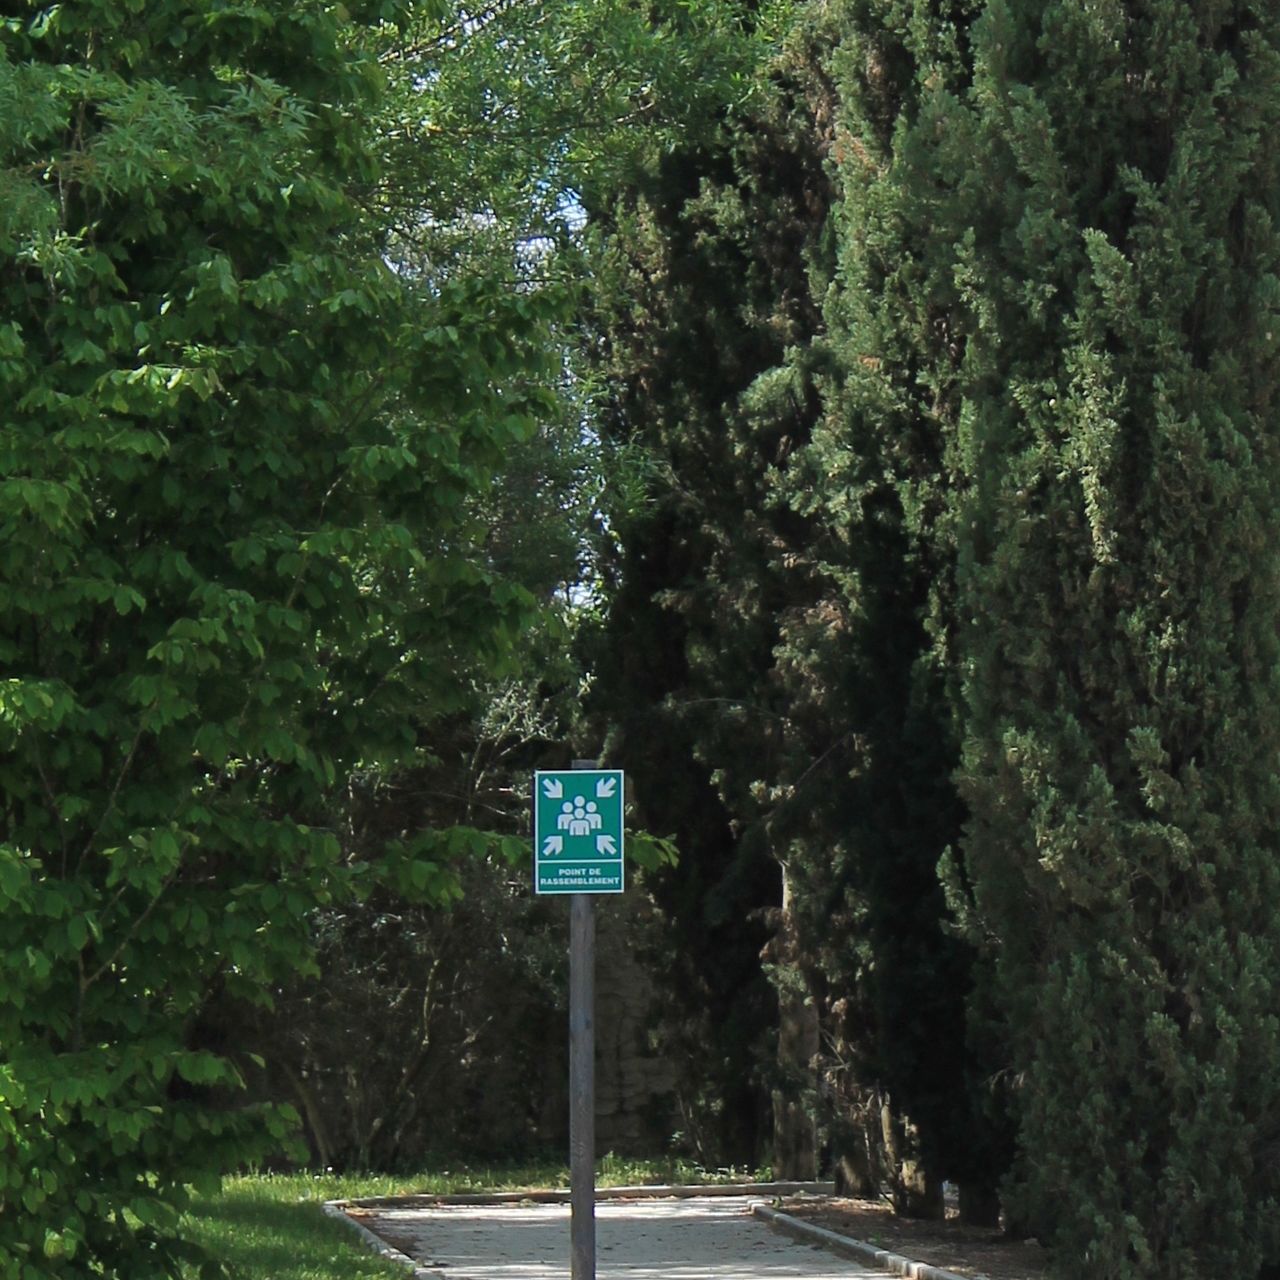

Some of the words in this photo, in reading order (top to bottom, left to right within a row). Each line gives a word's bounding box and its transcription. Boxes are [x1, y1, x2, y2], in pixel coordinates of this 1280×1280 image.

[558, 868, 587, 876] POINT
[588, 868, 601, 876] DE
[540, 877, 620, 885] RASSEMBLEMENT
